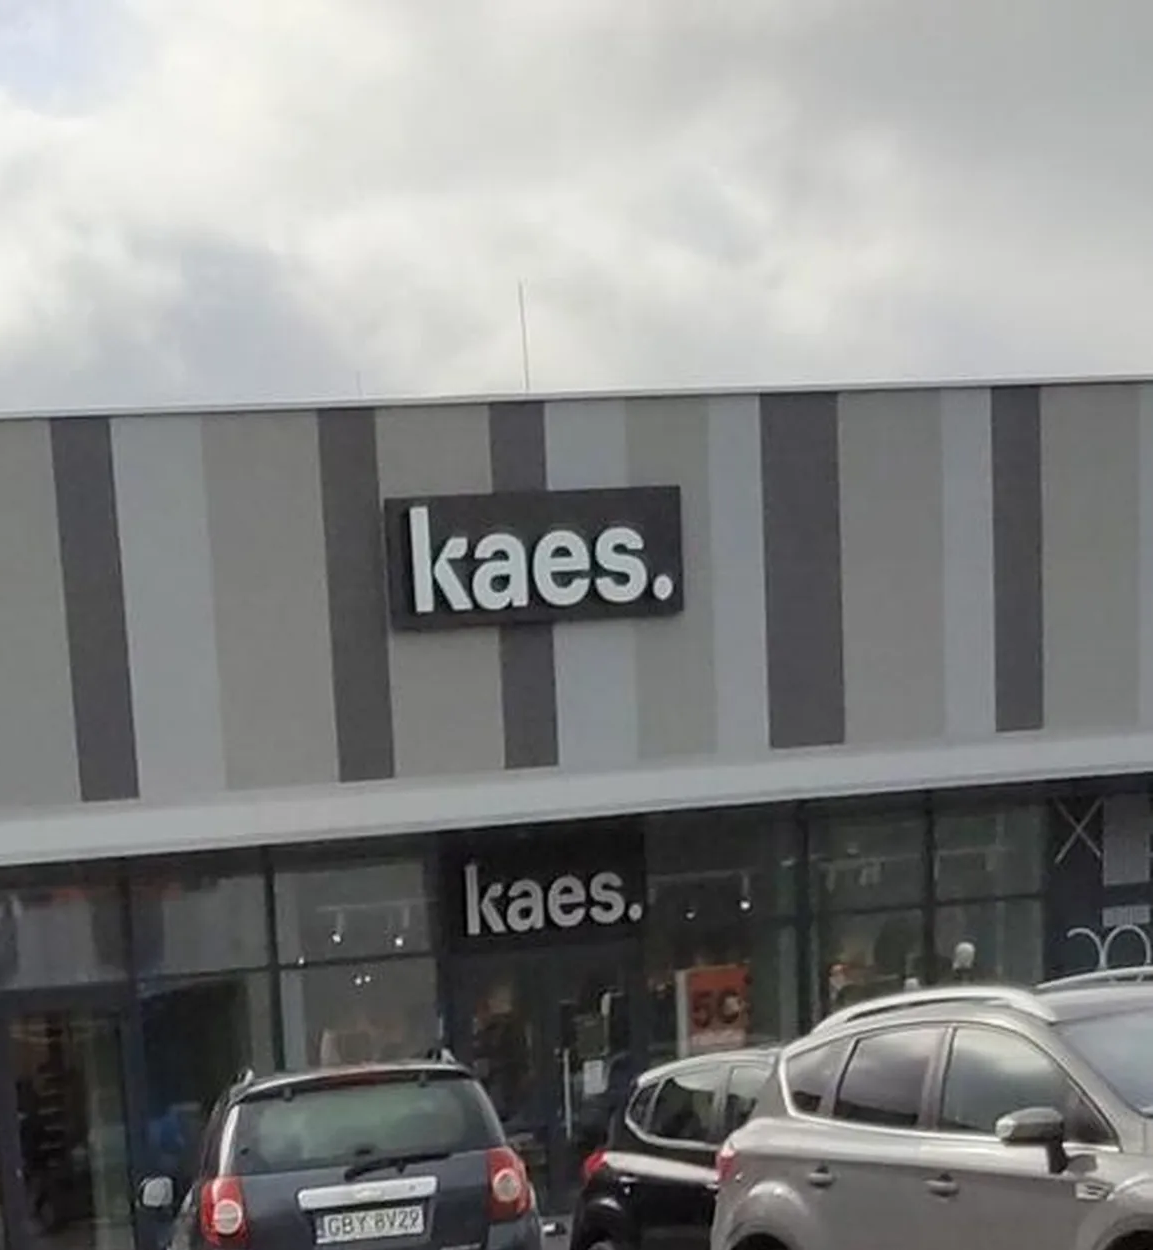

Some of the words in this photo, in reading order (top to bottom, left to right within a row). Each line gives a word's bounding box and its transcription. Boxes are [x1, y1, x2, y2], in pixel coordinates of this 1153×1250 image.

[409, 506, 673, 613] kaes.
[465, 862, 643, 935] kaes.
[327, 1215, 371, 1236] GBY
